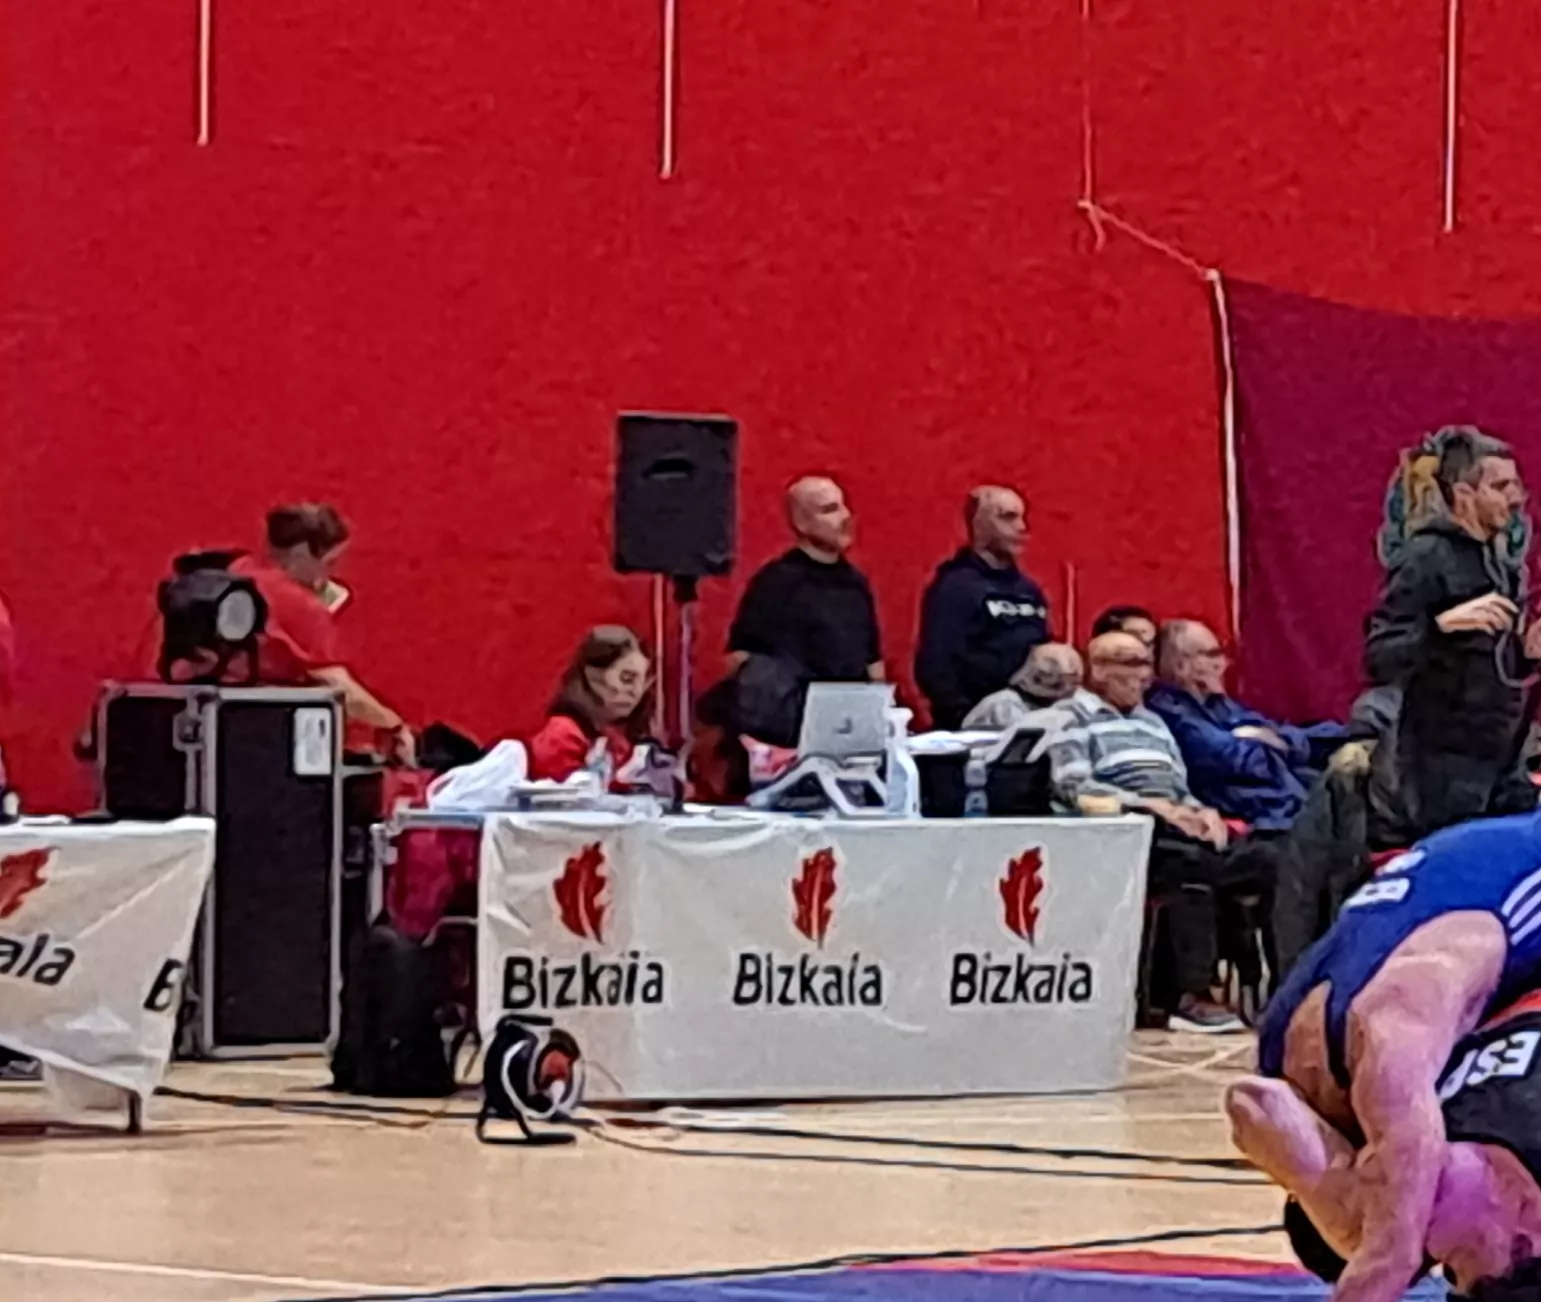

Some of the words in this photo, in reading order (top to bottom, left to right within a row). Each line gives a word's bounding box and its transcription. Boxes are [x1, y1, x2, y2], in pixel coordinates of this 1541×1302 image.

[502, 950, 663, 1009] Bizkaia
[733, 952, 882, 1006] Bizkaia
[950, 952, 1092, 1006] Bizkaia
